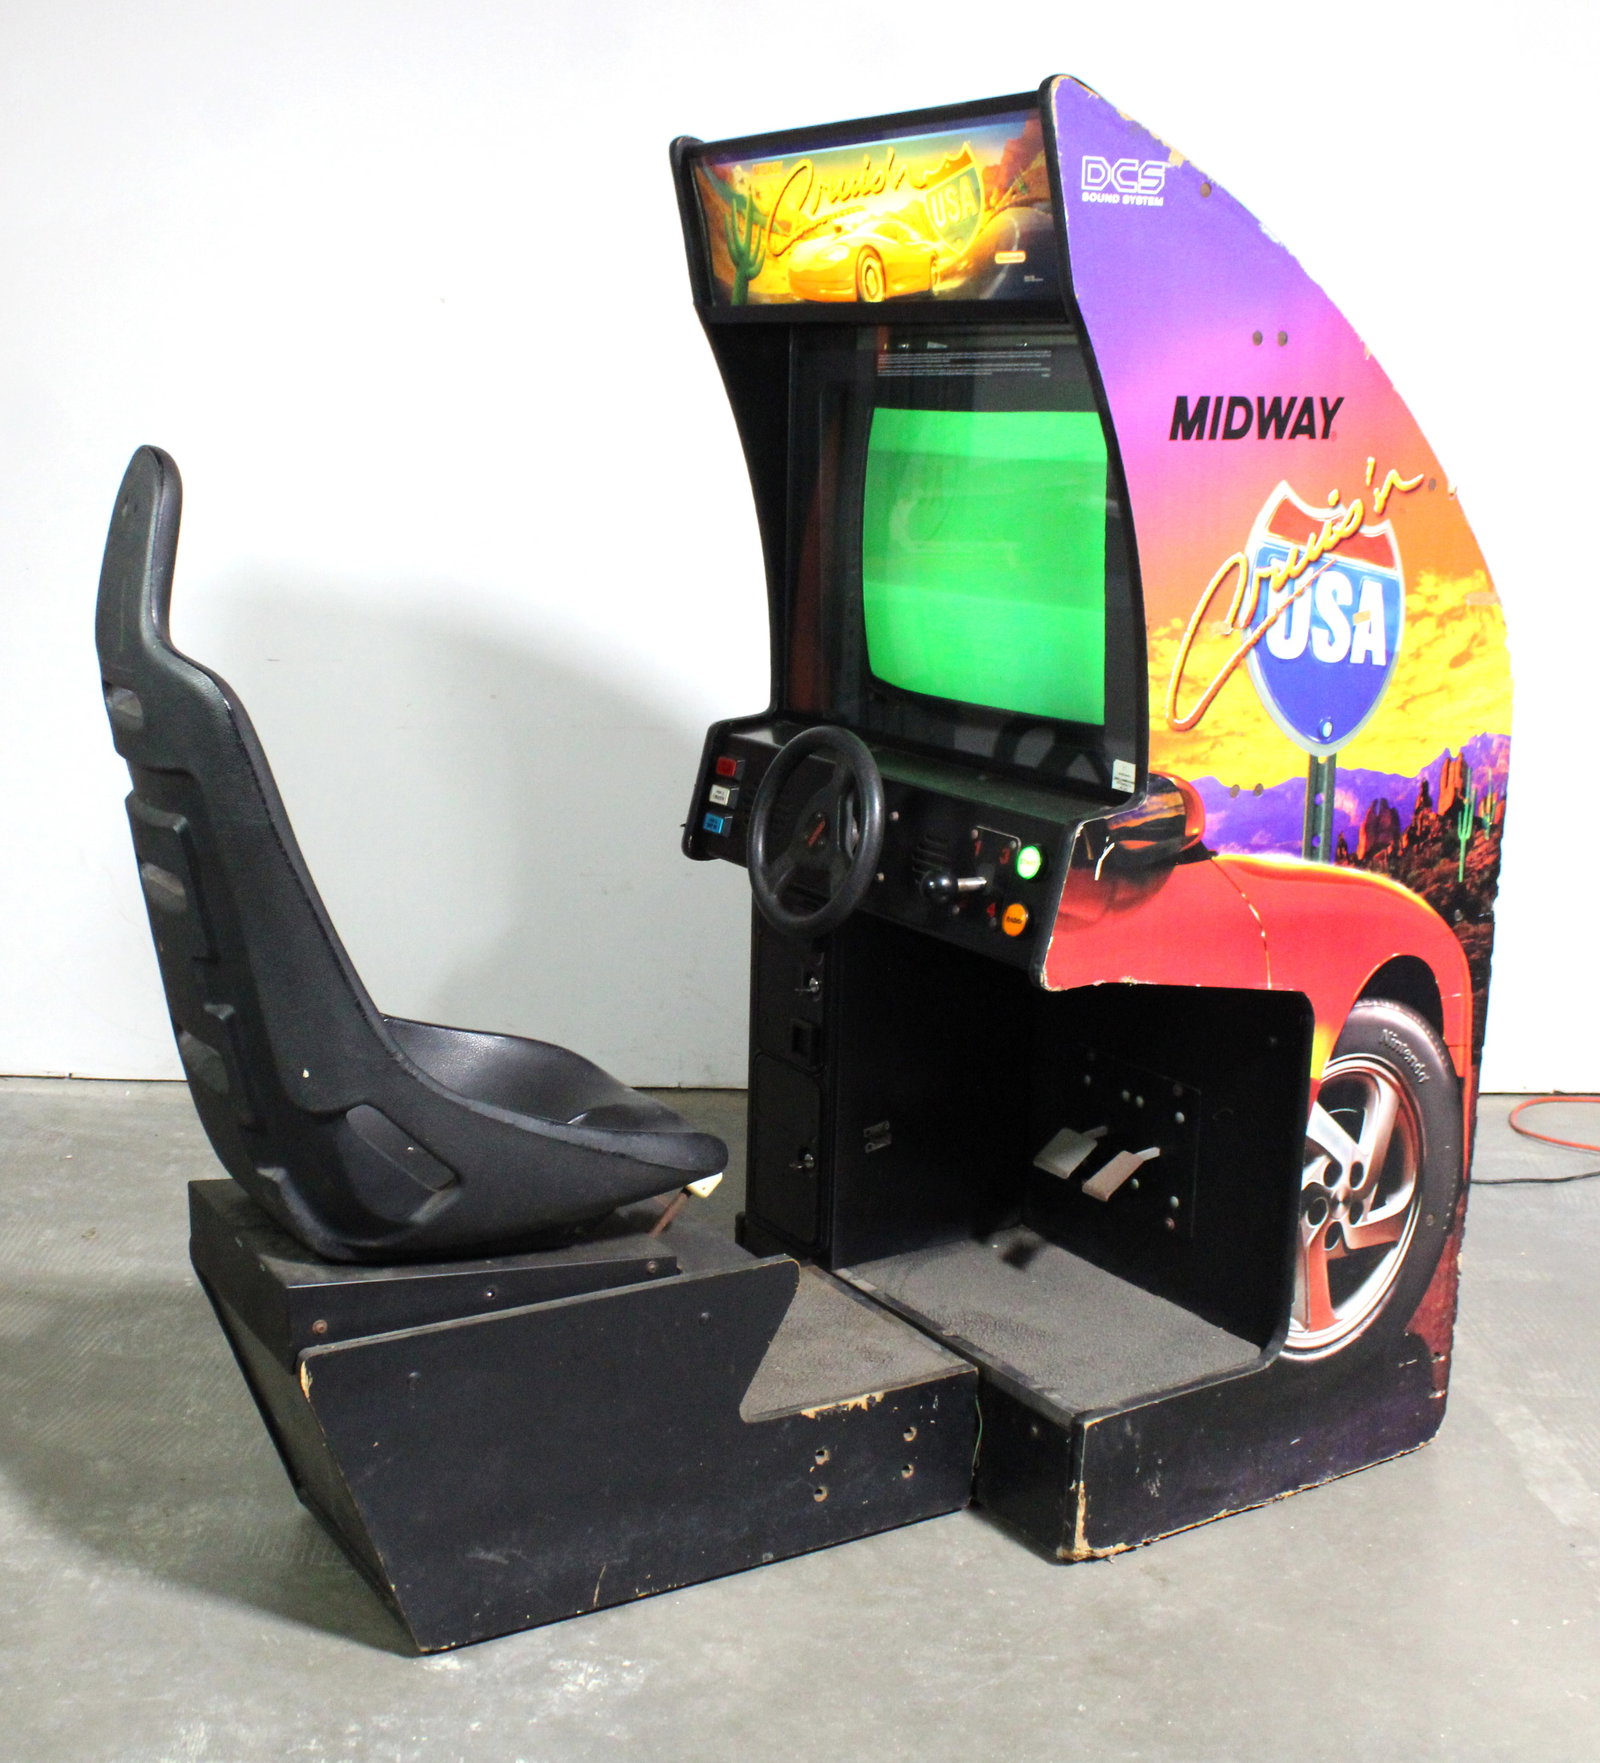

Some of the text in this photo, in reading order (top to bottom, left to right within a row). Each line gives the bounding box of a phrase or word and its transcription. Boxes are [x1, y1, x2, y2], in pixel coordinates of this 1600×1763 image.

[1081, 155, 1167, 195] DCS
[1081, 191, 1164, 207] SOUND SYSTEM
[931, 174, 979, 229] USA
[1169, 395, 1345, 441] MIDWAY
[1166, 456, 1425, 731] Cruis'n USA
[1379, 1028, 1430, 1083] Nintendo
